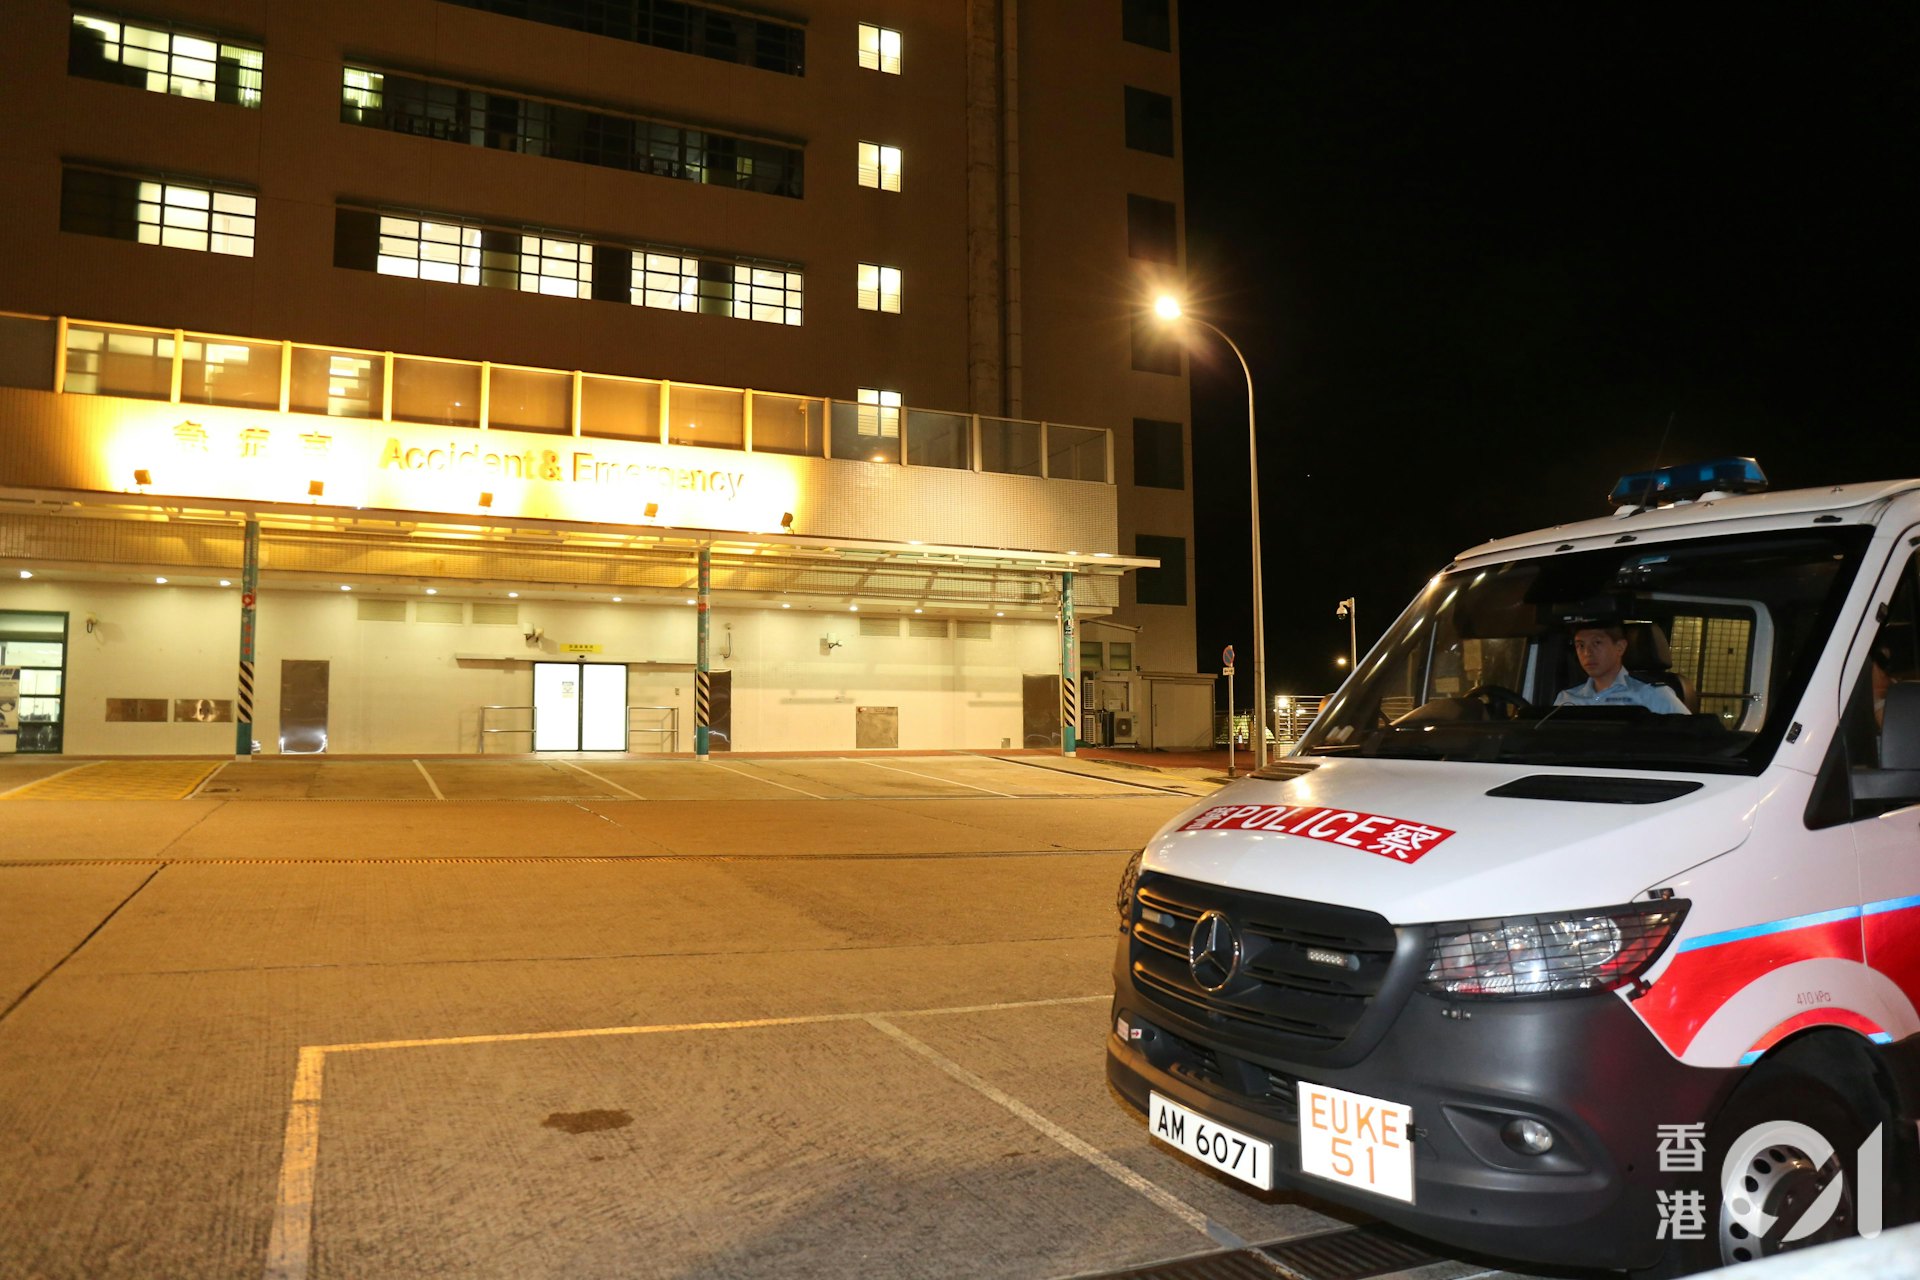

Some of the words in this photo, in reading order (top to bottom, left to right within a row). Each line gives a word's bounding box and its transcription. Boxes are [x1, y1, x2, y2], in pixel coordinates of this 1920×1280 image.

[539, 449, 565, 481] &
[1157, 1105, 1184, 1145] AM
[1196, 1124, 1256, 1179] 6071
[1311, 1092, 1400, 1149] EUKE
[1331, 1136, 1375, 1184] 51
